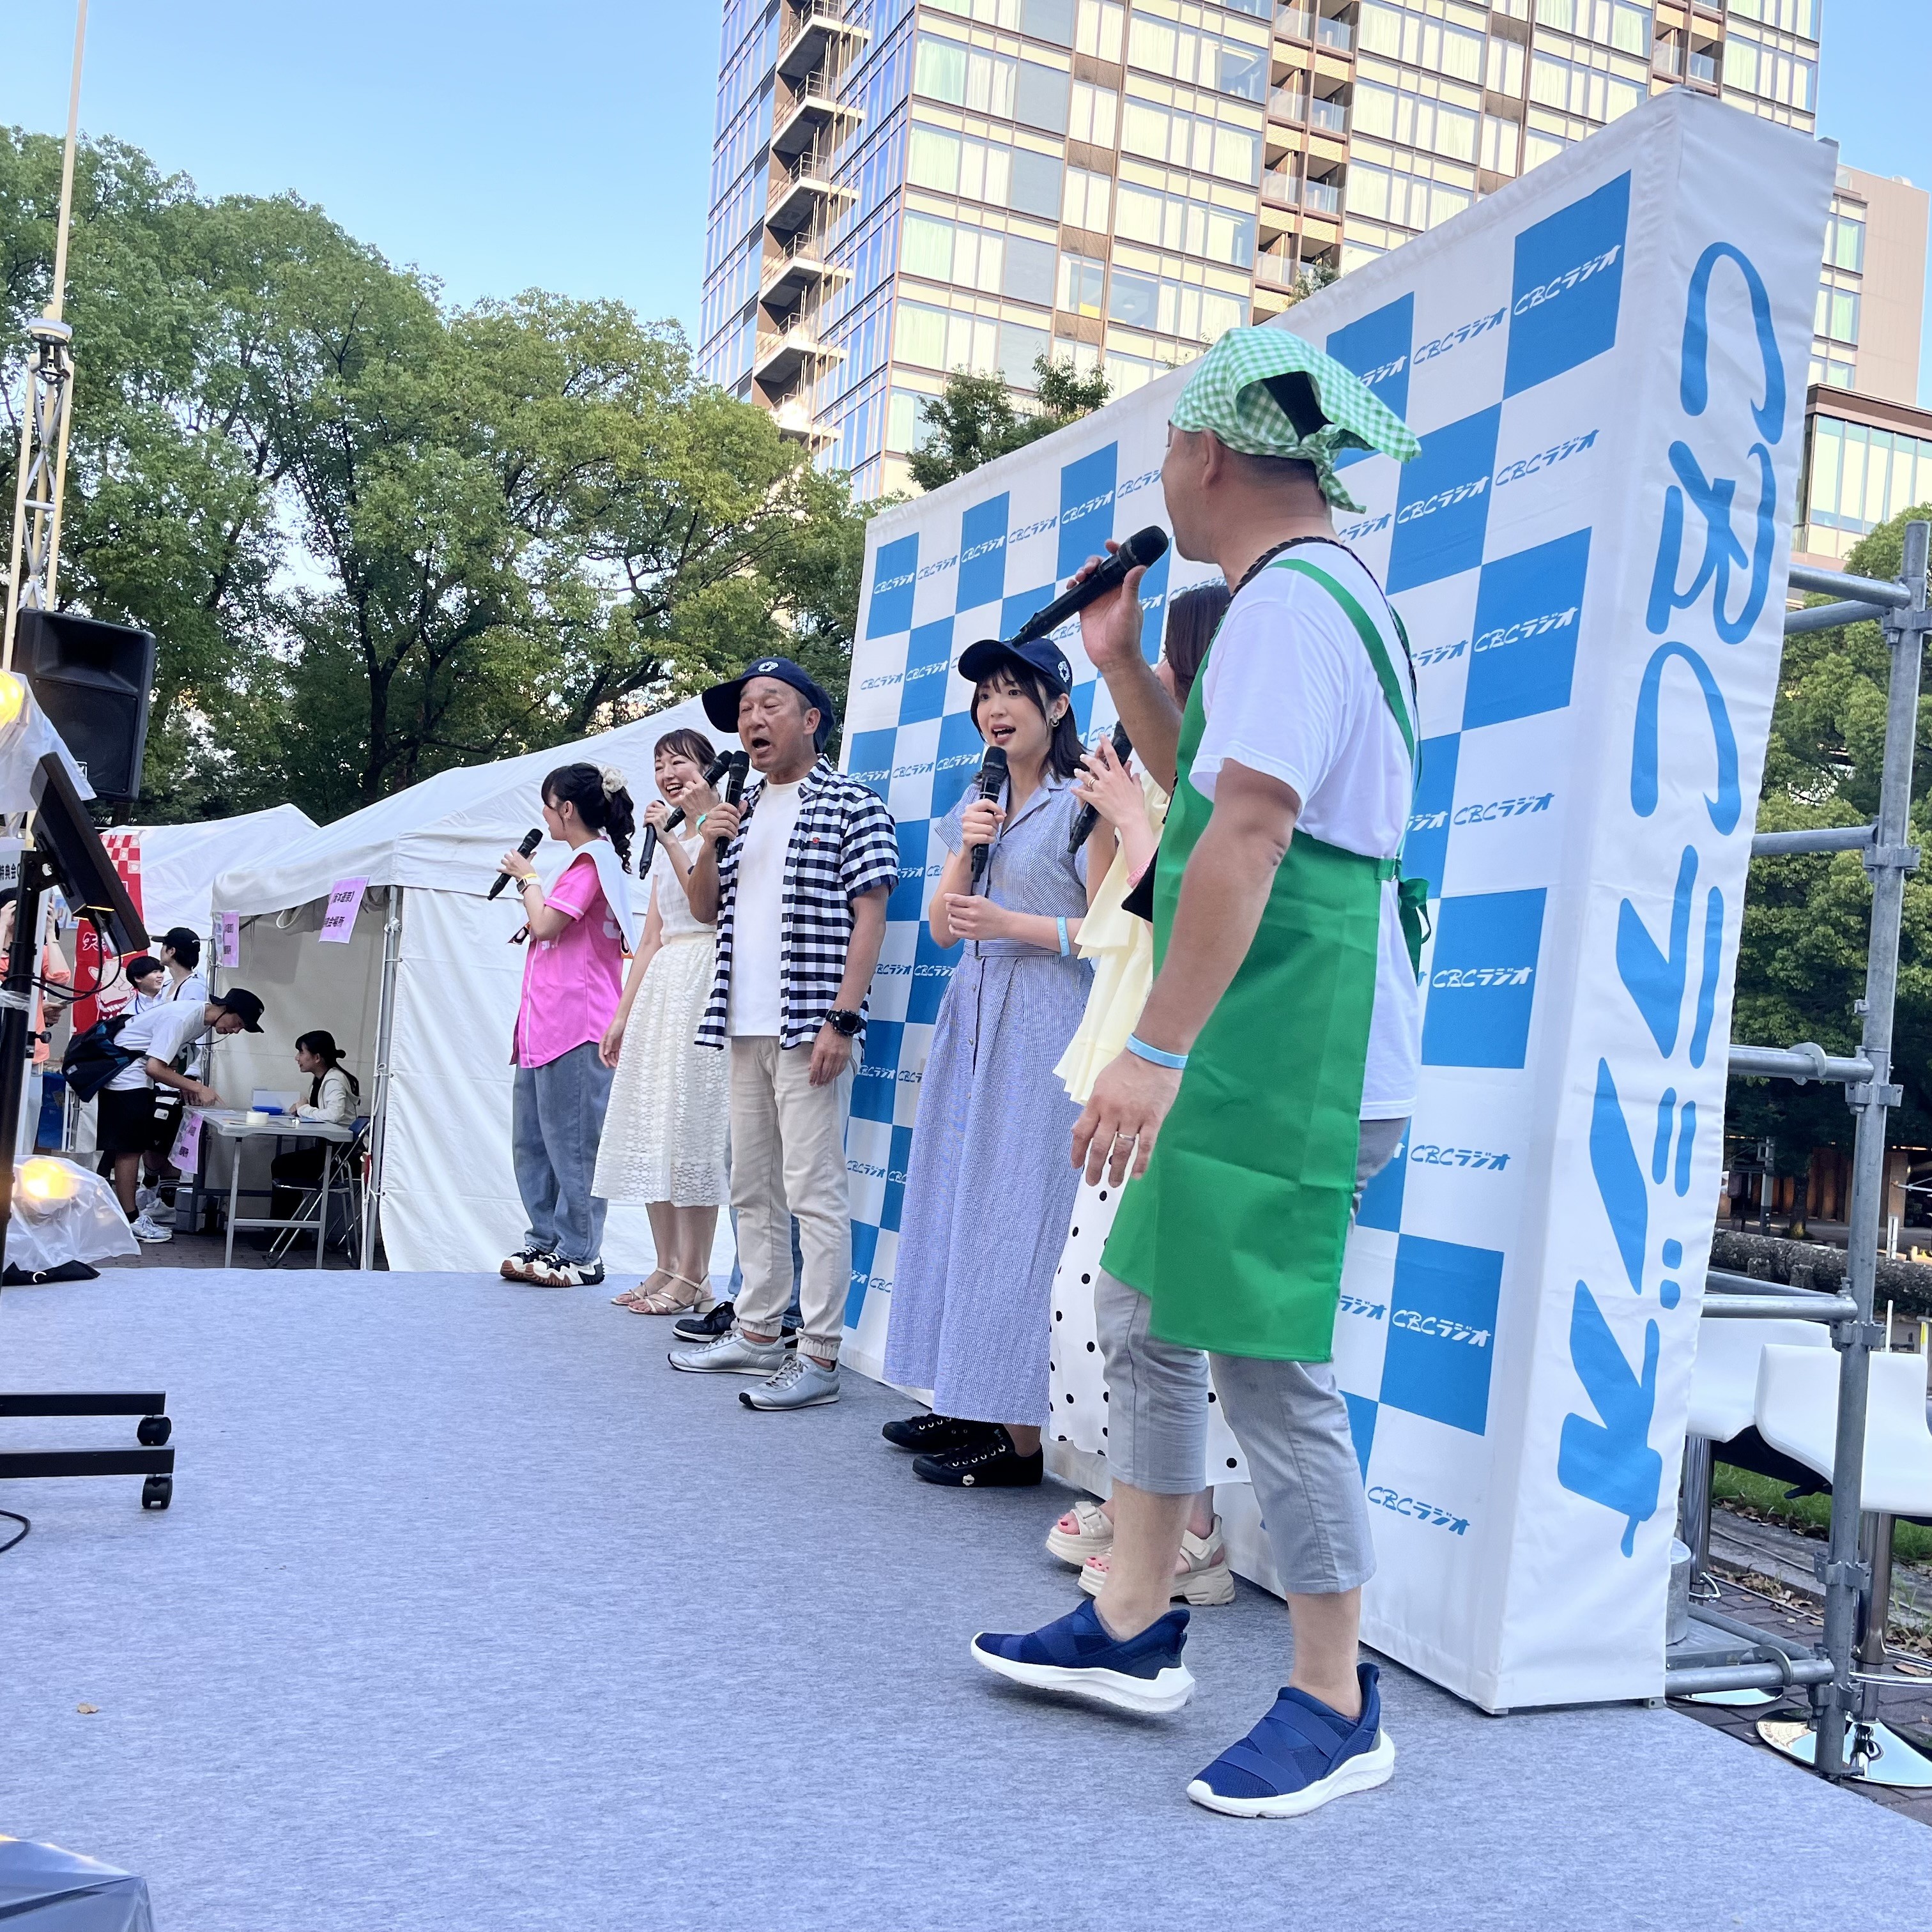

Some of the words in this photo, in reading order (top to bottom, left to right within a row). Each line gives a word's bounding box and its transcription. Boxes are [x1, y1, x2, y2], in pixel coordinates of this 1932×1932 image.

[1514, 245, 1621, 316] CBCラジオ
[1413, 307, 1508, 365] CBCラジオ
[1356, 355, 1408, 388] ラジオ
[1496, 429, 1600, 486] CBCラジオ
[1117, 469, 1162, 498] CBCラジ
[1061, 490, 1114, 525] CBCラジオ
[1397, 475, 1490, 524] CBCラジオ
[1008, 516, 1057, 544] CBCラジオ
[961, 535, 1006, 563] CBCラジオ
[917, 555, 958, 580] CBCラジオ
[873, 572, 915, 595] CBCラジオ
[1474, 606, 1578, 653] CBCラジオ
[860, 673, 904, 690] CBCラジオ
[905, 659, 949, 682] CBCラジオ
[893, 762, 935, 778] CBCラジオ
[937, 753, 981, 771] CBCラジオ
[1453, 792, 1555, 825] CBCラジオ
[1558, 241, 1786, 1558] CBCラジオ
[875, 963, 912, 974] BCラジオ
[1432, 967, 1533, 988] CBCラジオ
[898, 1070, 923, 1083] CBCラ
[847, 1160, 886, 1178] CBCラジオ
[1410, 1145, 1510, 1170] CBCラジオ
[870, 1278, 893, 1292] CBC
[1339, 1295, 1387, 1320] ラジオ
[1392, 1310, 1491, 1347] CBCラジオ
[1367, 1486, 1471, 1536] CBCラジオ
